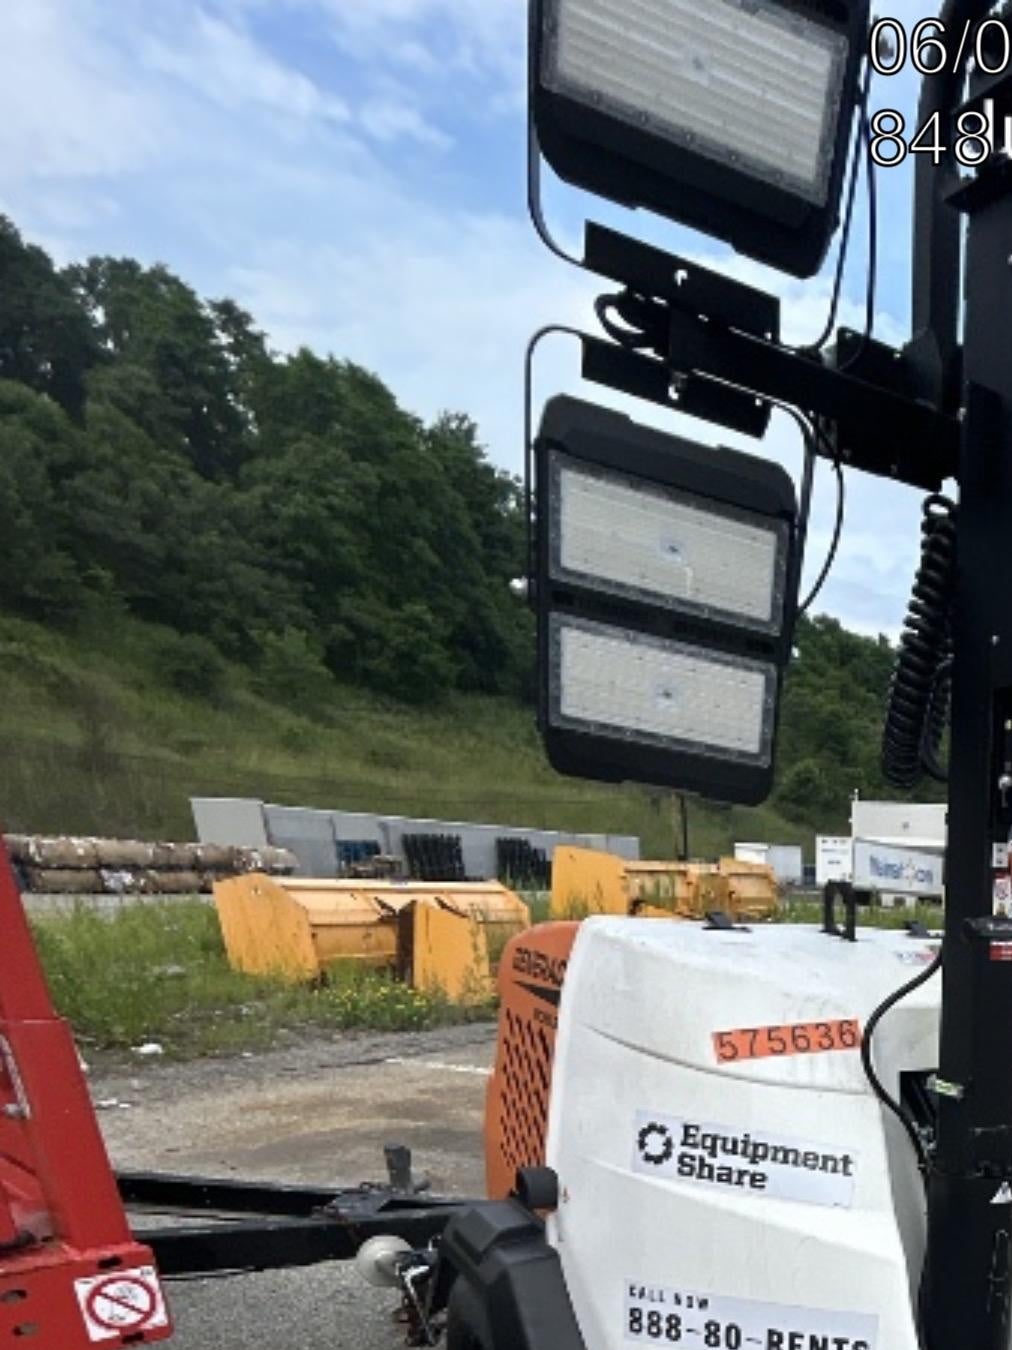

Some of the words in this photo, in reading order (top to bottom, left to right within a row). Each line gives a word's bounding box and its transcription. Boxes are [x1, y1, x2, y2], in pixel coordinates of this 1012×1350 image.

[716, 1019, 857, 1061] 575636
[676, 1151, 769, 1190] Share
[679, 1123, 854, 1177] Equipment
